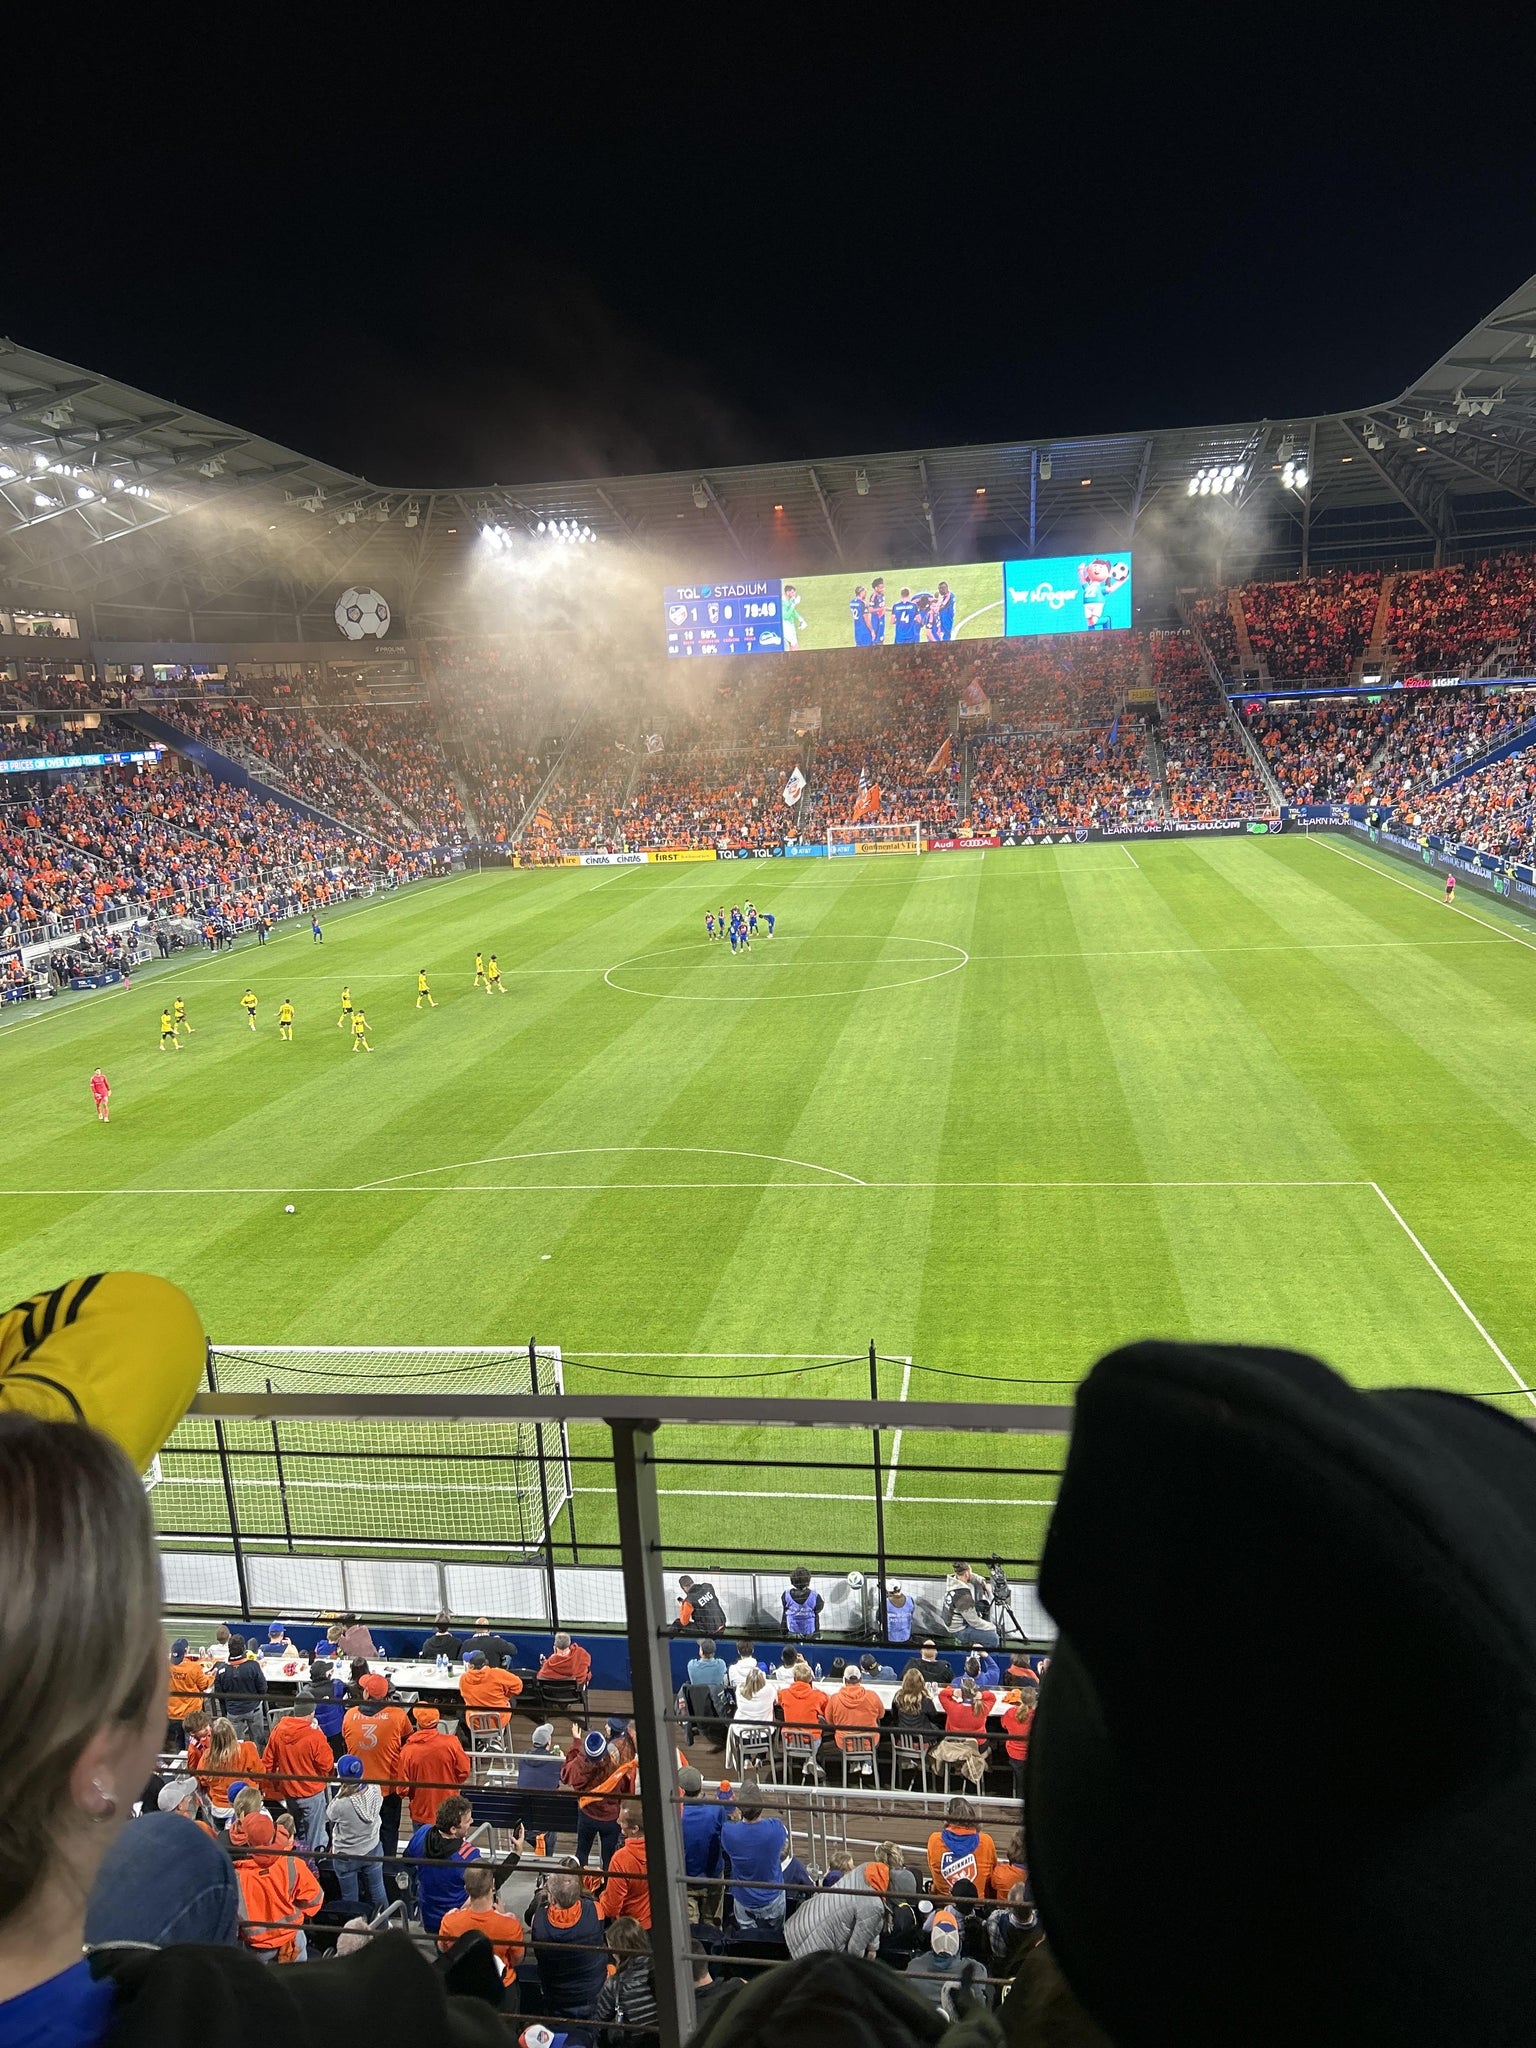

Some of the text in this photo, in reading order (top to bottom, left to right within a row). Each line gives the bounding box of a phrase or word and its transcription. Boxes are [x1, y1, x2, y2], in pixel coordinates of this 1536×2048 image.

[677, 584, 767, 600] TQL STADIUM
[1030, 581, 1079, 610] Kroger
[1404, 677, 1460, 689] Coors LIGHT
[1298, 817, 1329, 826] LEARN
[1102, 826, 1133, 835] LEARN
[1134, 825, 1162, 834] MORE
[934, 841, 954, 849] Audi
[718, 850, 738, 860] TQL
[753, 849, 773, 859] TQL
[697, 1591, 714, 1607] ENG
[358, 1723, 378, 1751] 3
[945, 1855, 953, 1863] FC
[943, 1855, 974, 1877] CINCINNATI
